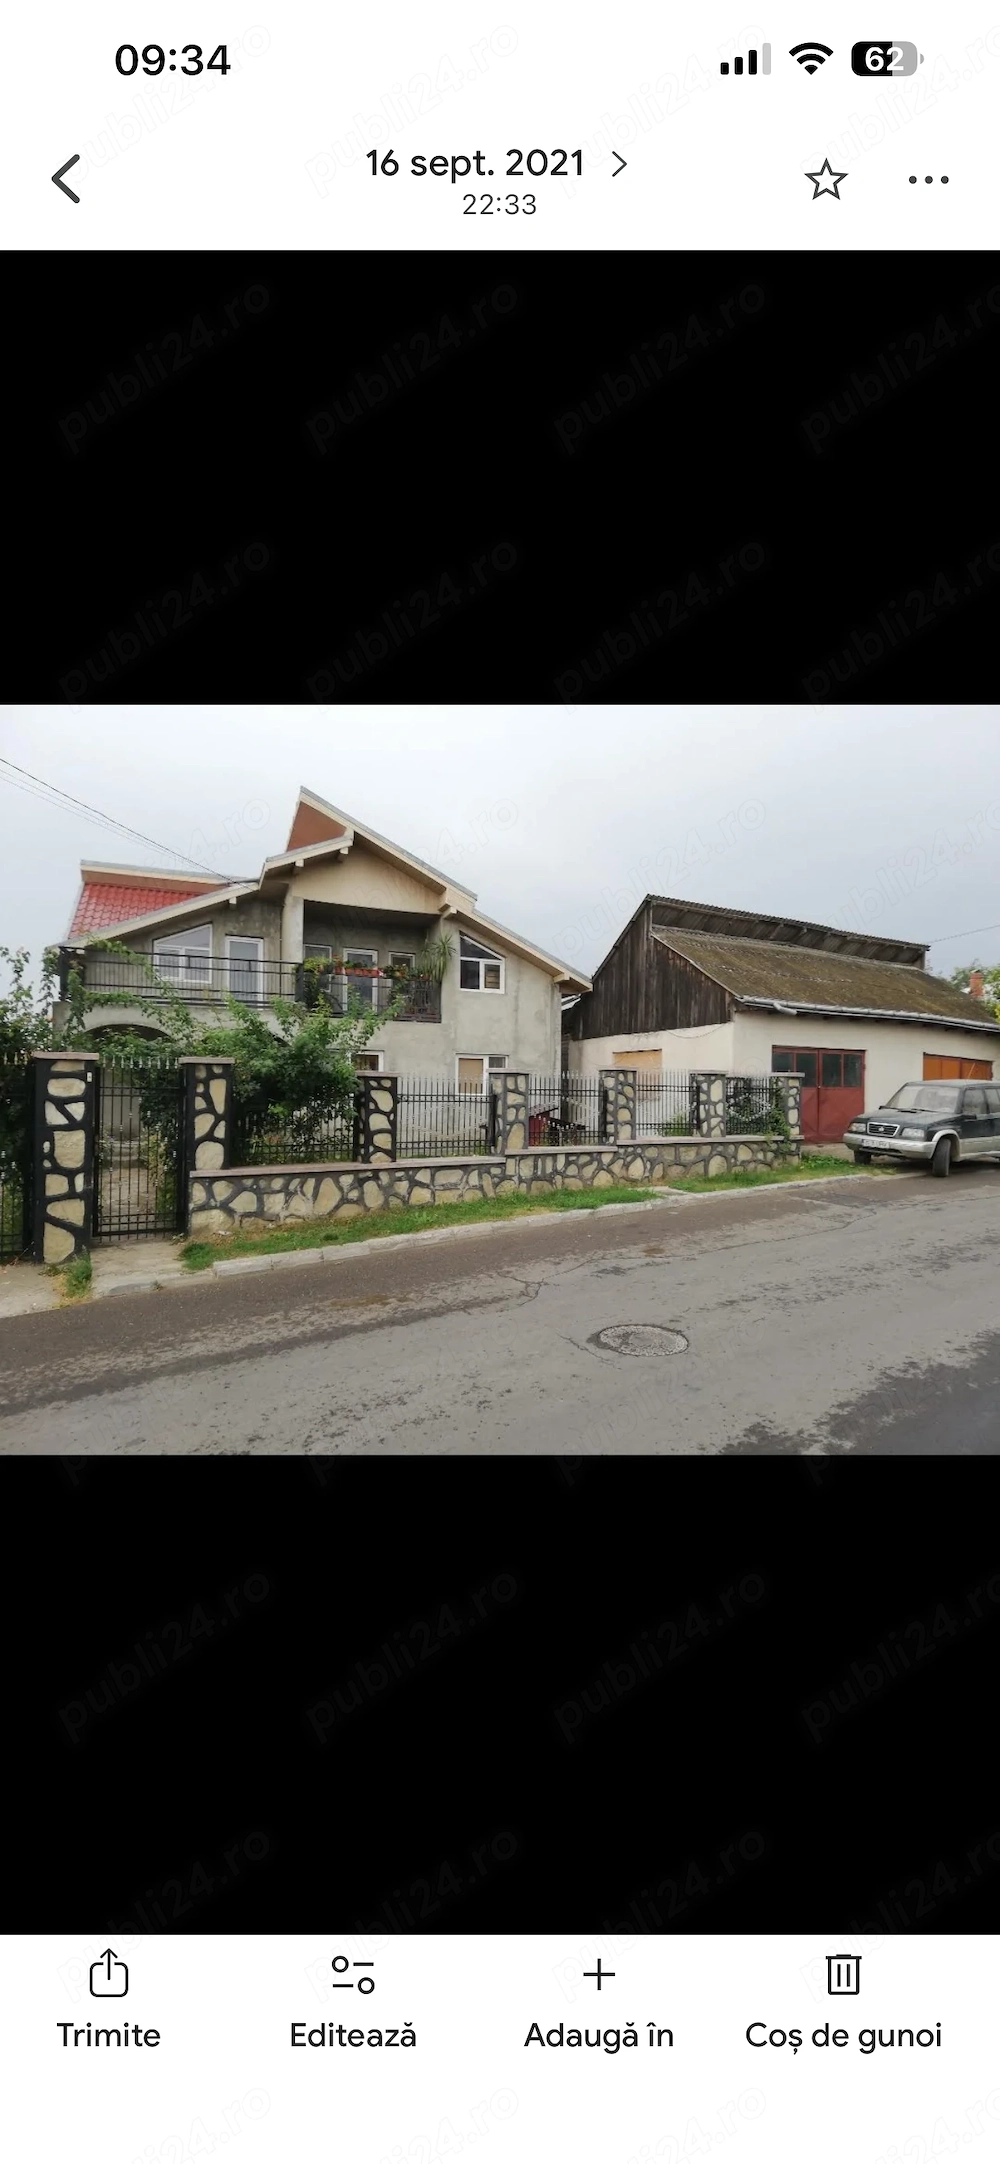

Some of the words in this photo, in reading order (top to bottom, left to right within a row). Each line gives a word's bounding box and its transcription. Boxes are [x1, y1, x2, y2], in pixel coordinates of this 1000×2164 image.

[115, 44, 232, 76] 09:34
[865, 46, 904, 71] 62
[366, 149, 400, 177] 16
[410, 150, 495, 184] sept.
[505, 148, 582, 177] 2021
[462, 193, 537, 215] 22:33
[56, 2021, 161, 2048] Trimite
[291, 2021, 417, 2048] Editează
[523, 2021, 639, 2055] Adaugă
[646, 2021, 674, 2048] în
[745, 2021, 803, 2056] Coș
[811, 2022, 850, 2048] de
[858, 2021, 942, 2055] gunoi
